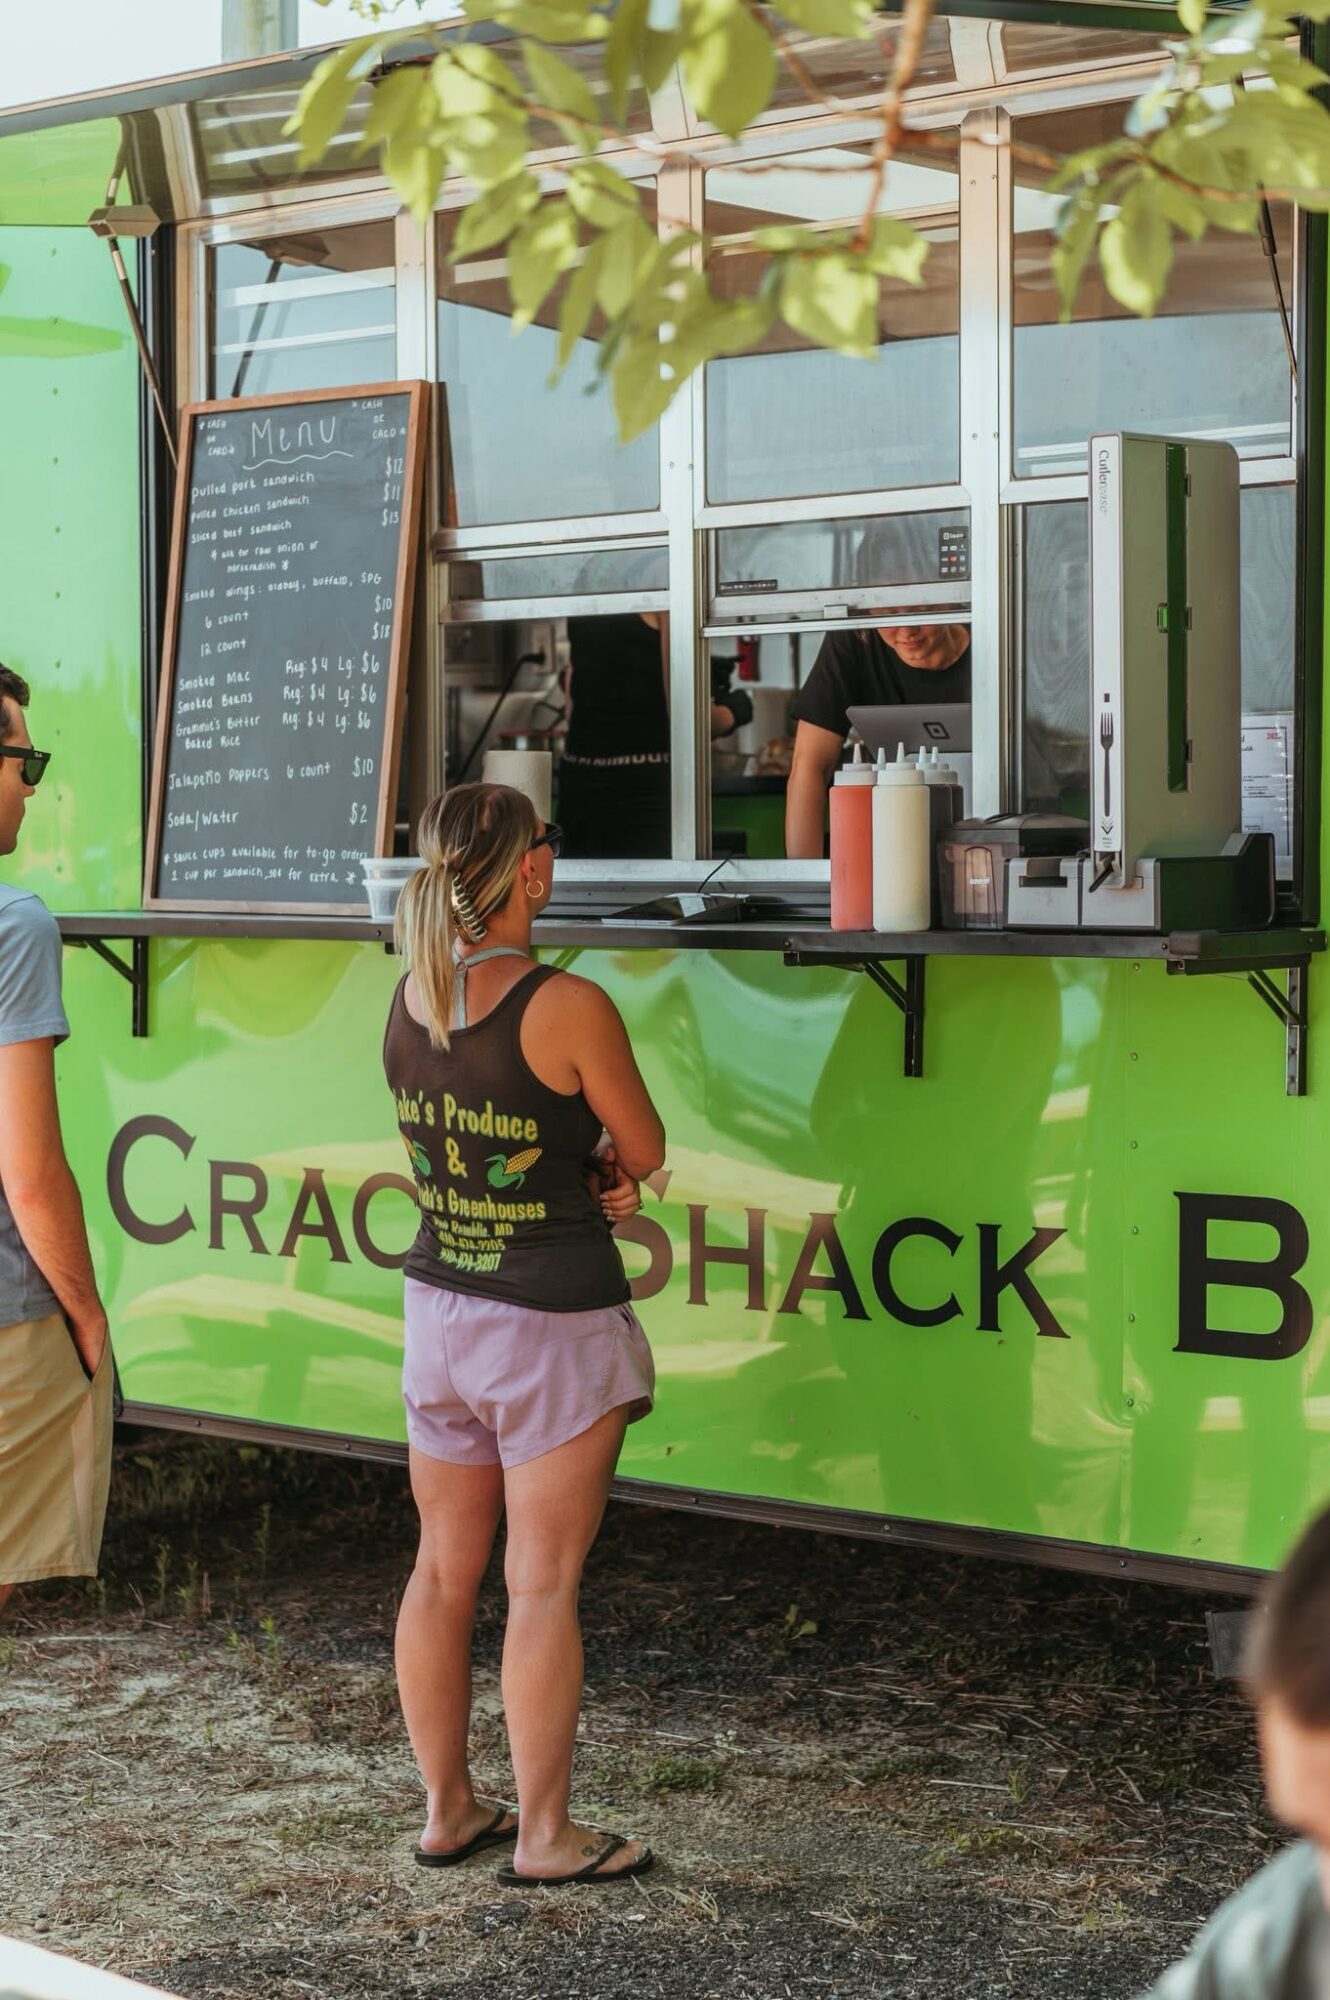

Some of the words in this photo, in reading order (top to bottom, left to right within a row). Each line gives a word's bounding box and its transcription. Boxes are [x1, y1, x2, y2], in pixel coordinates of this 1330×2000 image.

[361, 401, 383, 410] CASH
[232, 479, 256, 495] pork
[263, 471, 316, 487] sandwich
[386, 456, 404, 478] $12
[266, 495, 310, 510] sandwich
[384, 482, 400, 502] $11
[223, 526, 242, 538] beef
[250, 519, 292, 535] sandwich
[382, 508, 399, 526] $13
[222, 549, 235, 559] ask
[239, 548, 249, 557] for
[277, 541, 304, 553] onion
[309, 541, 319, 550] or
[227, 561, 276, 573] horseradish
[360, 571, 382, 585] SPG
[205, 615, 213, 629] 6
[218, 610, 249, 625] count
[375, 593, 392, 613] $10
[201, 642, 212, 657] 12
[217, 637, 247, 653] count
[372, 621, 391, 640] $18
[180, 674, 215, 691] Smoked
[227, 671, 250, 684] Mac
[361, 650, 380, 675] $6
[178, 697, 213, 714] Smoked
[222, 691, 253, 707] Beans
[361, 682, 377, 704] $6
[227, 715, 261, 730] Butter
[357, 709, 371, 729] $6
[185, 737, 213, 750] Baked
[220, 734, 241, 748] Rice
[169, 768, 221, 790] Jalapeño
[287, 763, 294, 779] 6
[300, 761, 331, 777] count
[352, 755, 373, 777] $10
[349, 801, 367, 826] $2
[174, 851, 198, 863] sauce
[203, 847, 226, 859] cups
[232, 845, 277, 859] available
[283, 845, 299, 860] for
[306, 844, 336, 867] to-go
[341, 849, 368, 860] orders
[171, 869, 178, 881] 1
[184, 870, 199, 880] cup
[203, 868, 217, 880] per
[288, 867, 302, 880] for
[309, 872, 339, 883] extra
[392, 1087, 435, 1127] ake's
[443, 1092, 539, 1144] Produce
[445, 1136, 468, 1179] &
[447, 1186, 547, 1222] Greenhouses
[106, 1114, 420, 1270] CRAC
[611, 1169, 1071, 1339] SHACK
[493, 1222, 515, 1237] MD
